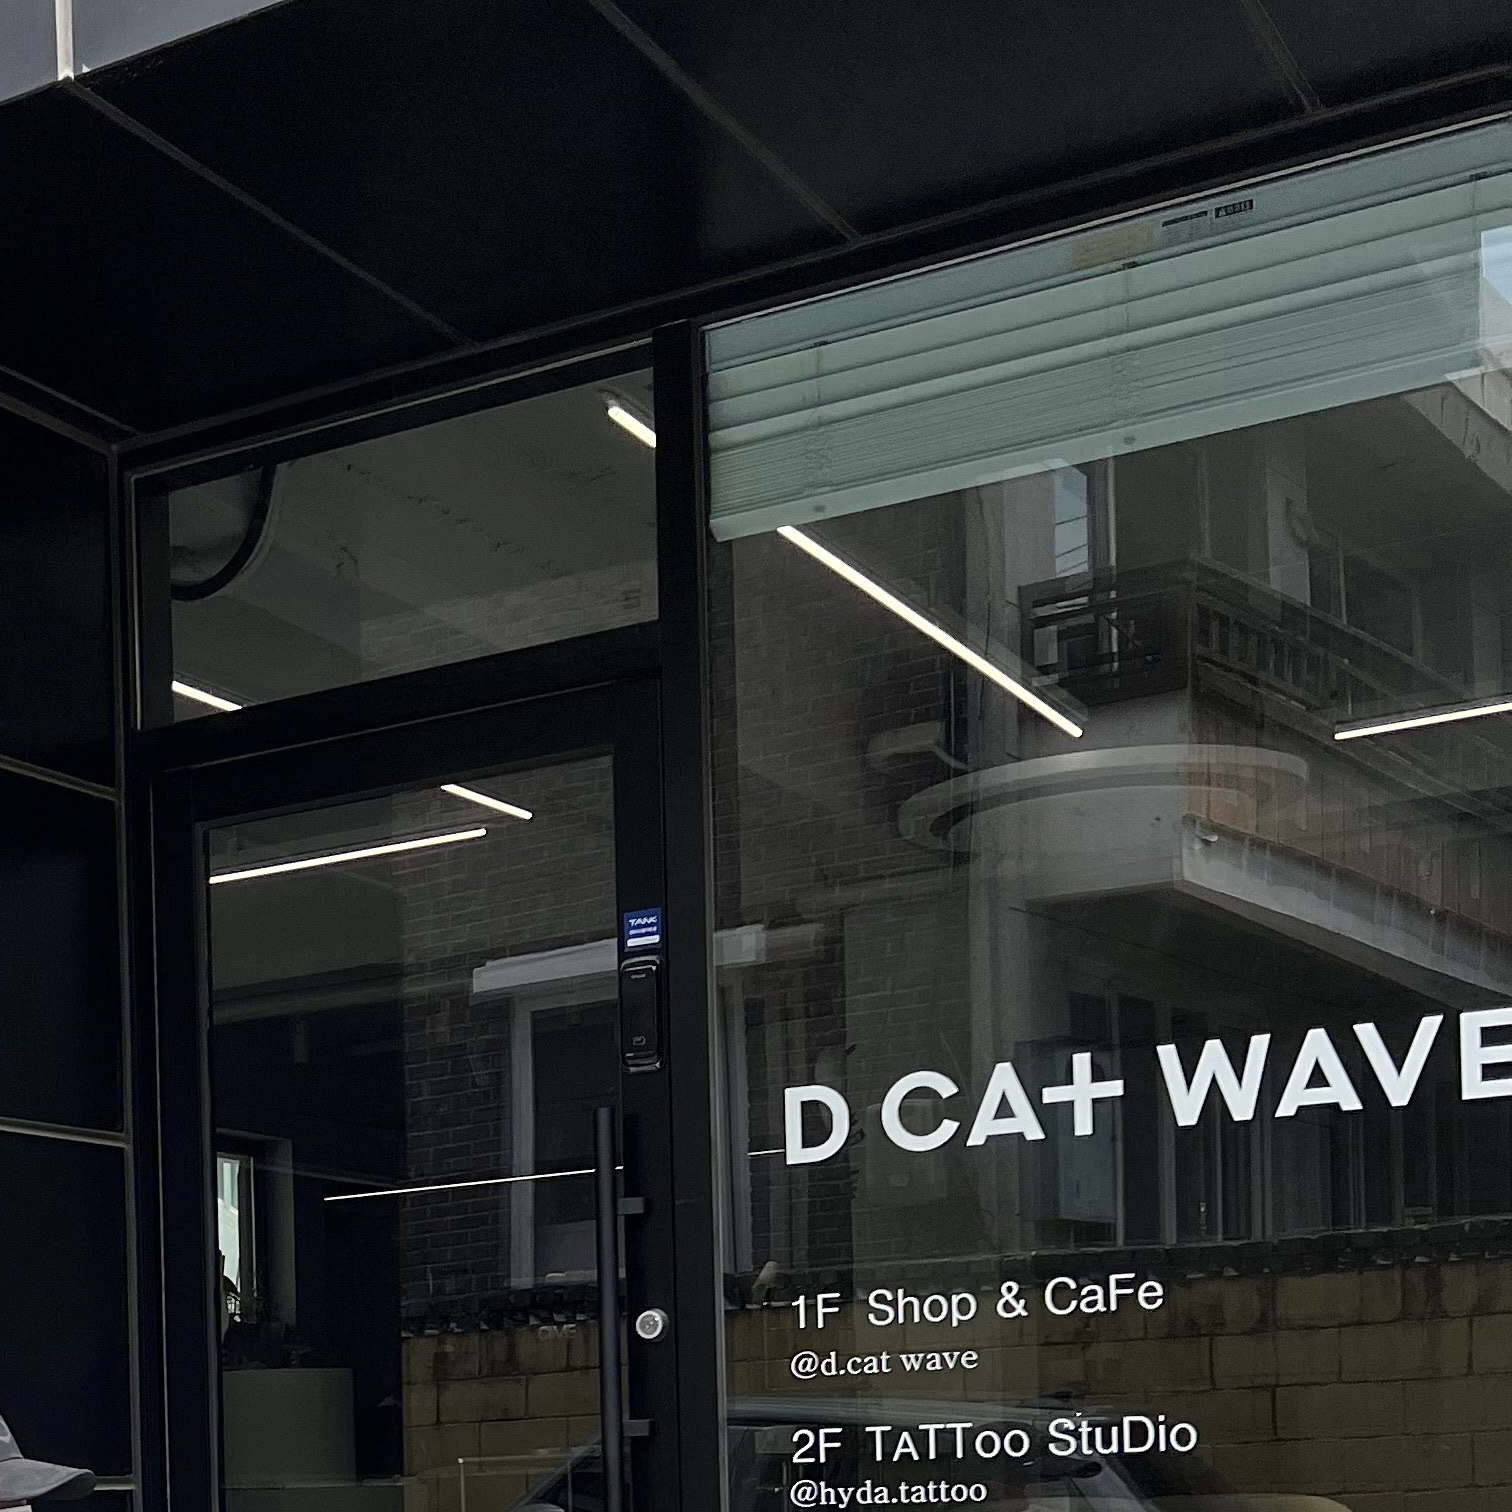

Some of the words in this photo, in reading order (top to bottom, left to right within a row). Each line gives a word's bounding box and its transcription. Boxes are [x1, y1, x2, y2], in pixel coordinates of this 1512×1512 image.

[784, 1085, 850, 1166] D
[1156, 1007, 1512, 1127] WAVE
[791, 1292, 841, 1329] 1F
[868, 1288, 978, 1327] Shop
[996, 1281, 1029, 1318] &
[1044, 1272, 1165, 1315] CaFe
[790, 1350, 892, 1380] @d.cat
[899, 1349, 979, 1372] wave
[791, 1427, 843, 1464] 2F
[1048, 1414, 1198, 1457] StuDio
[790, 1479, 988, 1509] @hyda.tattoo
